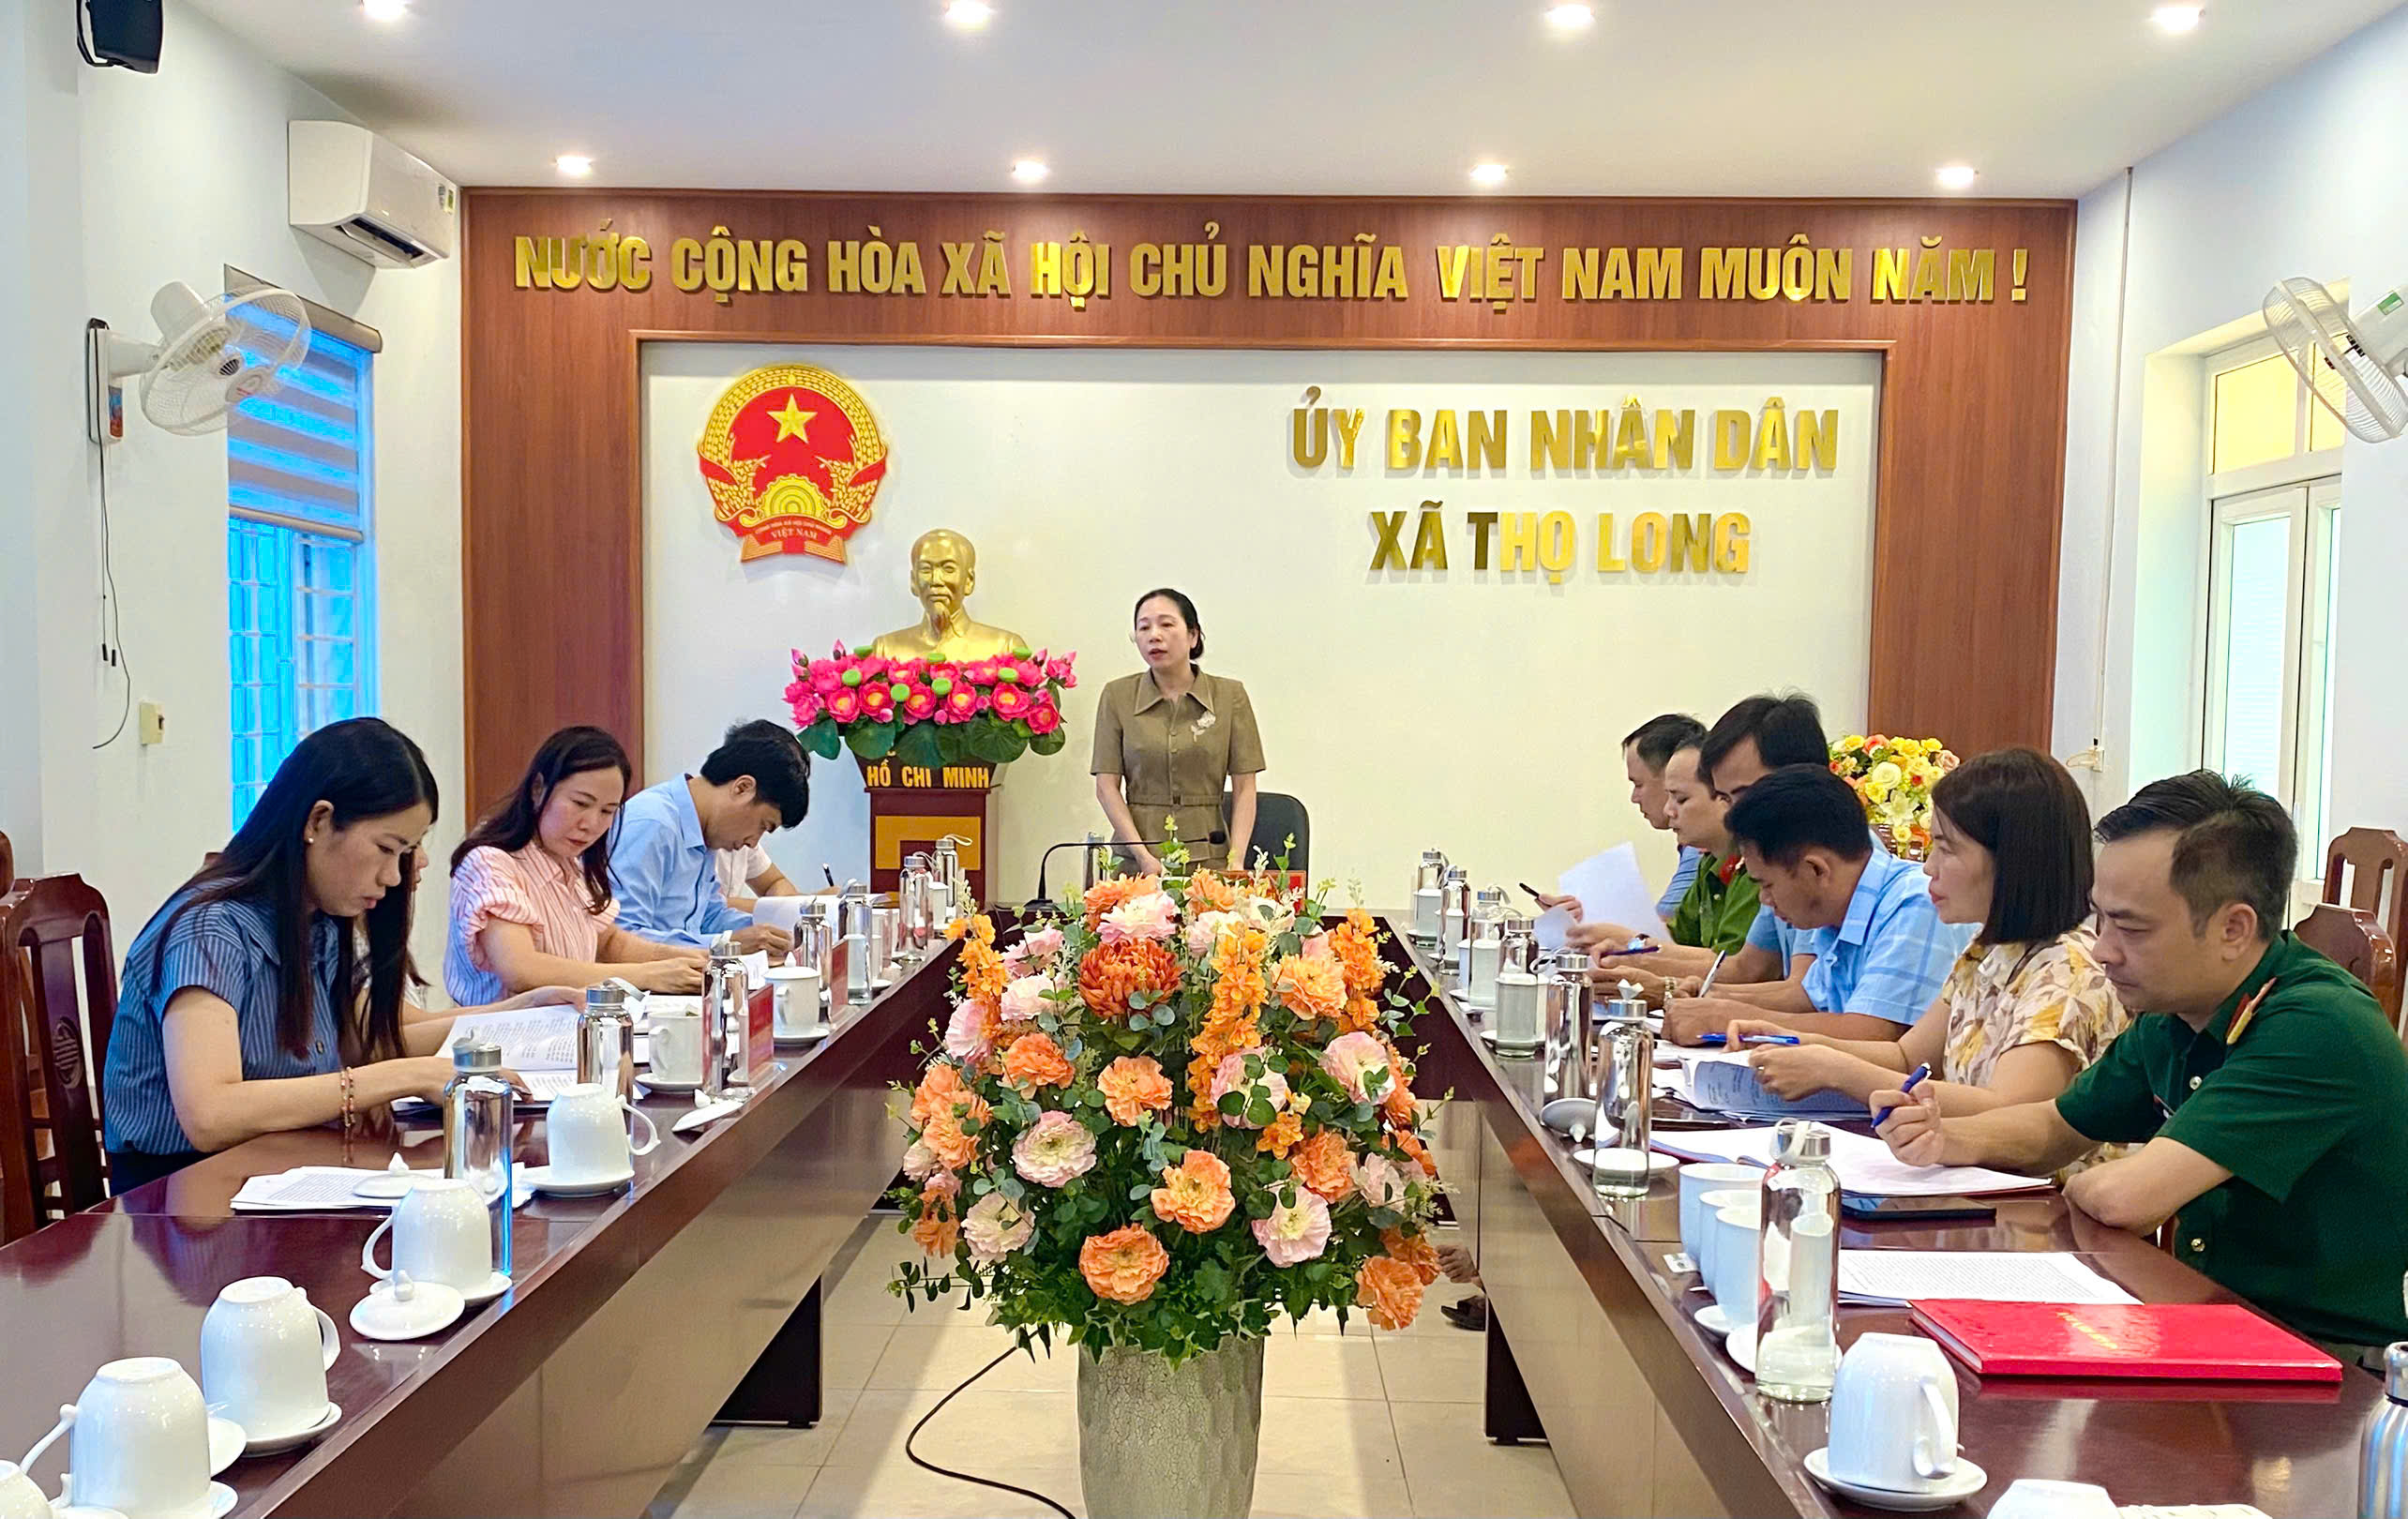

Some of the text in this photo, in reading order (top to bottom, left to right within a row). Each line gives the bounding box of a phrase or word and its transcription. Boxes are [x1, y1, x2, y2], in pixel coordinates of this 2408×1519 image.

[516, 219, 2029, 310] NƯỚC CỘNG HÒA XÃ HỘI CHỦ NGHĨA VIỆT NAM MUÔN NĂM !
[1292, 385, 1840, 470] ỦY BAN NHÂN DÂN
[796, 527, 818, 539] NAM
[1370, 500, 1751, 583] XÃ THỌ LONG
[942, 766, 990, 788] MINH
